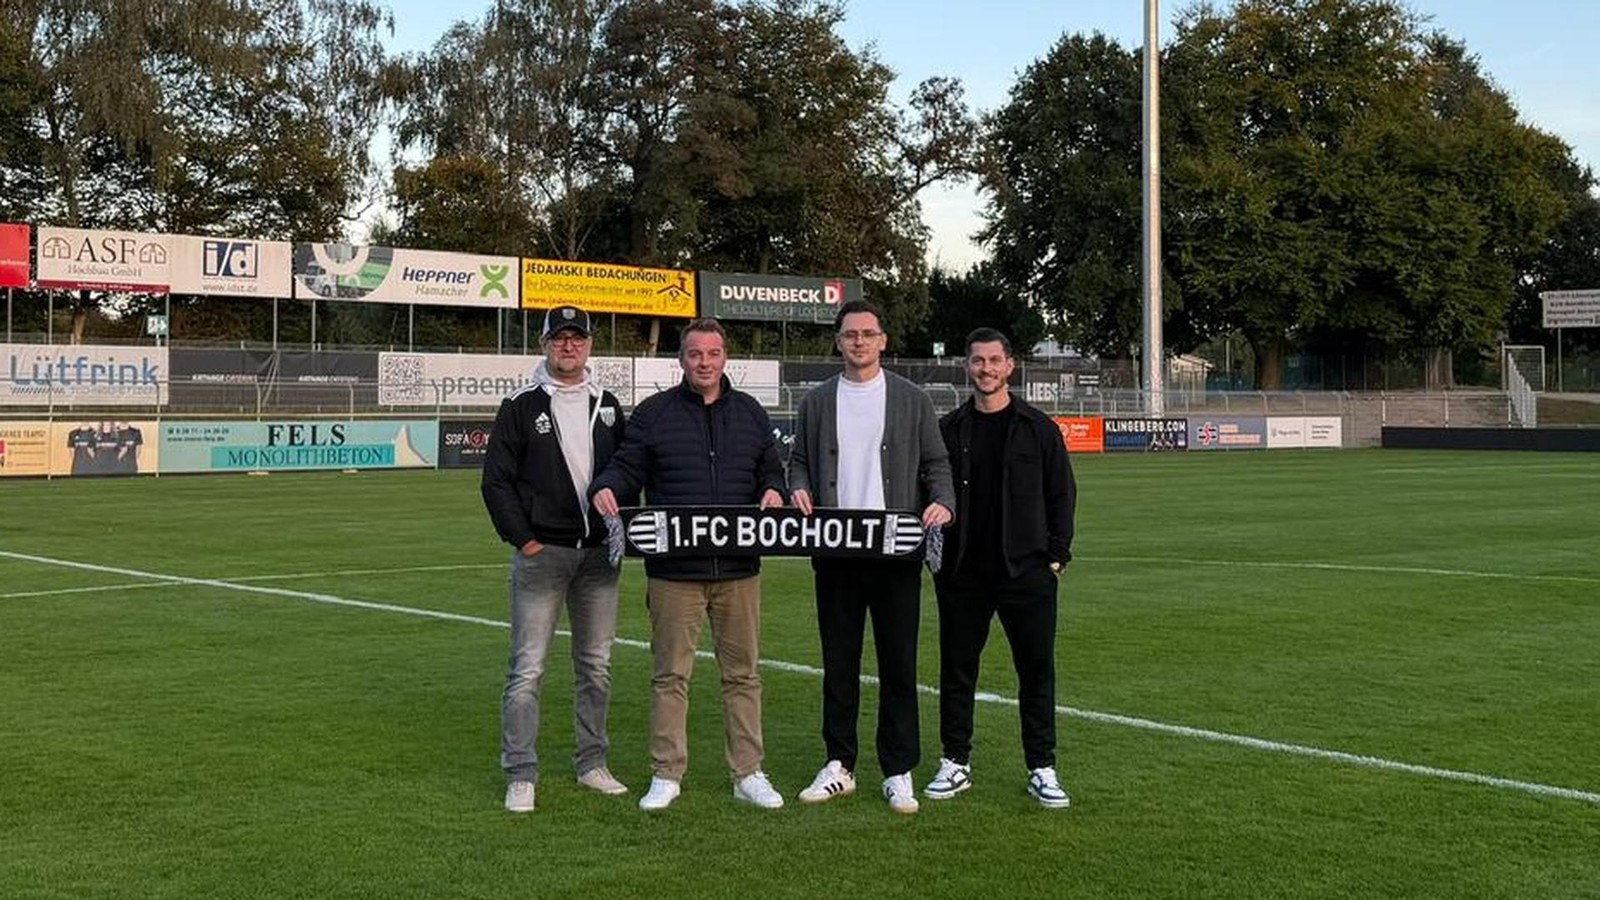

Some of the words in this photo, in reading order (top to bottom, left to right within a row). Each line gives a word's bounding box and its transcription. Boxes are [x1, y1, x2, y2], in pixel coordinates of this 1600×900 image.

[75, 237, 137, 264] ASF
[67, 264, 110, 275] Hochbau
[111, 266, 142, 277] GmbH
[525, 263, 583, 277] JEDAMSKI
[586, 266, 667, 284] BEDACHUNGEN
[415, 285, 469, 298] Hamacher
[720, 285, 821, 303] DUVENBECK
[10, 355, 158, 385] Lütfrink
[267, 424, 345, 447] FELS
[1105, 420, 1187, 433] KLINGEBERG.COM
[228, 447, 383, 467] MONOLITHBETON
[670, 515, 729, 547] 1.FC
[736, 516, 881, 549] BOCHOLT
